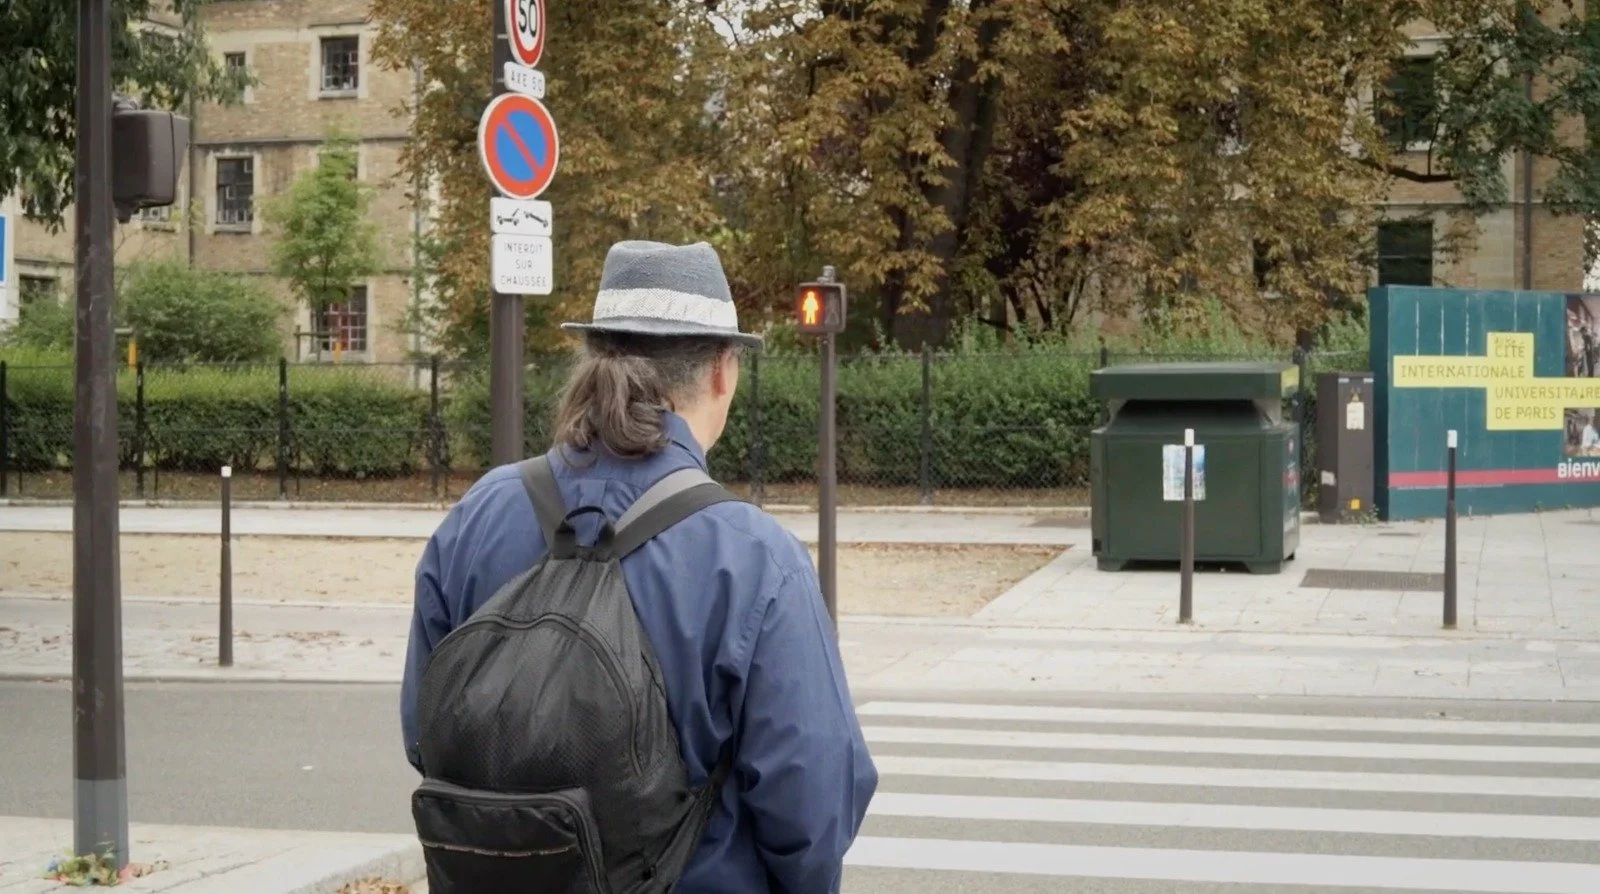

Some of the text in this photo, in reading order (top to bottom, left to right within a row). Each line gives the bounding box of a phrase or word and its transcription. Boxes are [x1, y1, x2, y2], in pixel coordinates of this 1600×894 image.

[518, 0, 538, 37] 50
[511, 71, 528, 88] AXE
[504, 243, 543, 254] INTERDIT
[515, 259, 533, 270] SUR
[1401, 364, 1525, 378] INTERNATIONALE
[1495, 386, 1600, 399] UNIVERSITAIRE
[1495, 406, 1556, 419] DE PARIS
